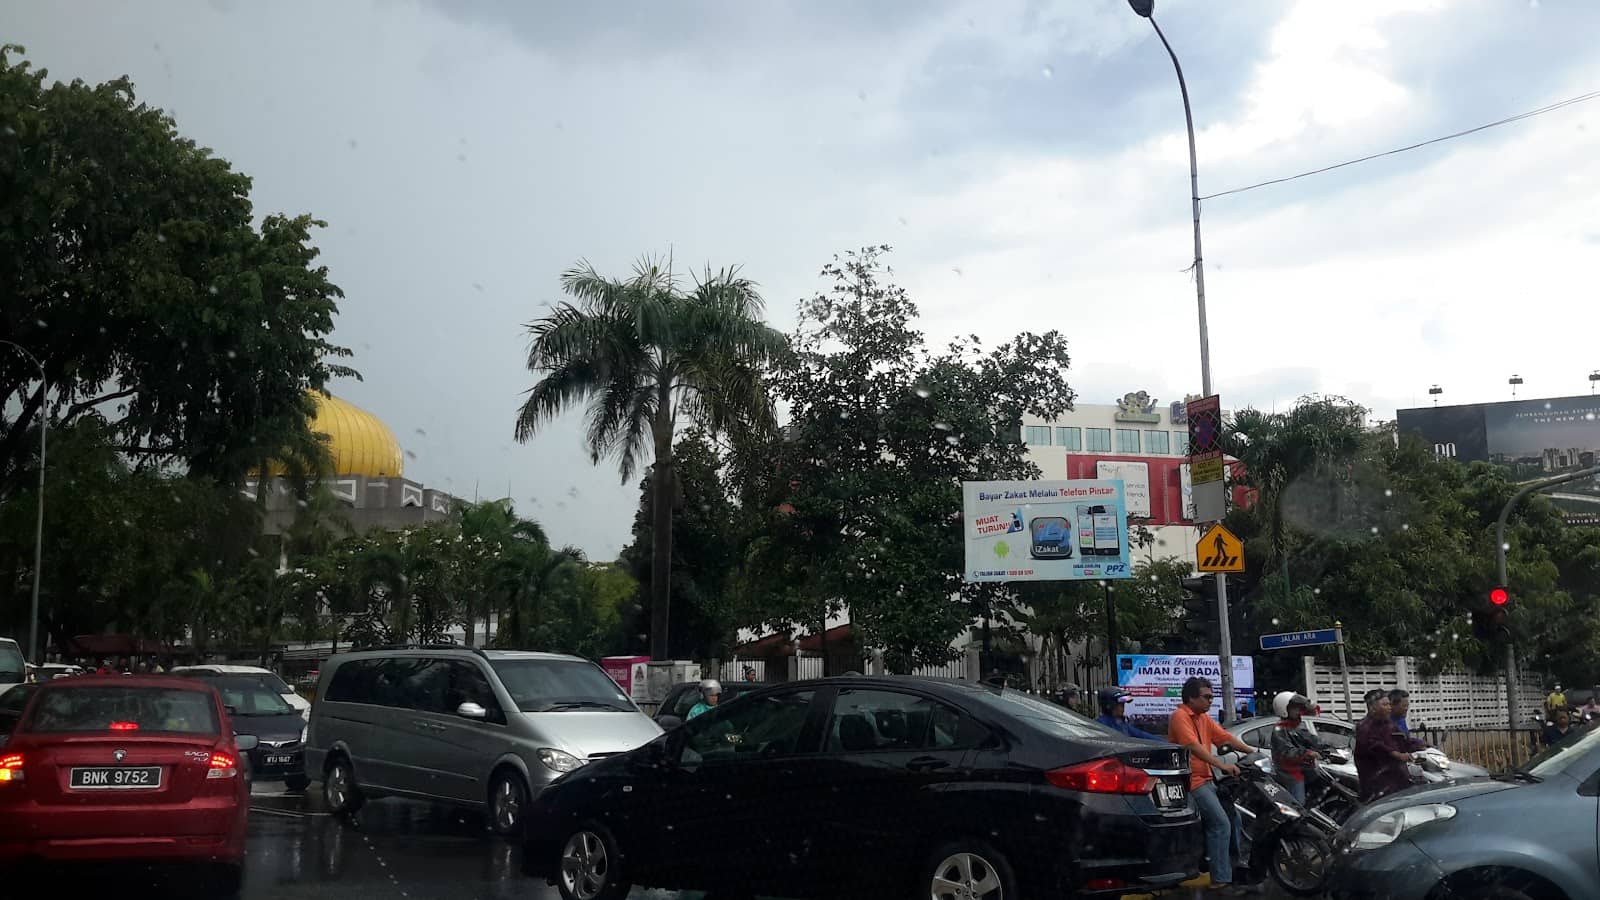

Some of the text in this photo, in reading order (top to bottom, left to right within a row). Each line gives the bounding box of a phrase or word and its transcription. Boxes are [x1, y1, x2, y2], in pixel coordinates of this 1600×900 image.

[979, 486, 1114, 501] Bayar Zakat Melalui Telefon Pintar
[975, 515, 999, 526] MUAT
[1035, 545, 1059, 553] iZakat
[1281, 632, 1317, 643] JALAN ARA
[1138, 667, 1220, 676] IMAN & IBADA
[82, 771, 149, 784] BNK 9752
